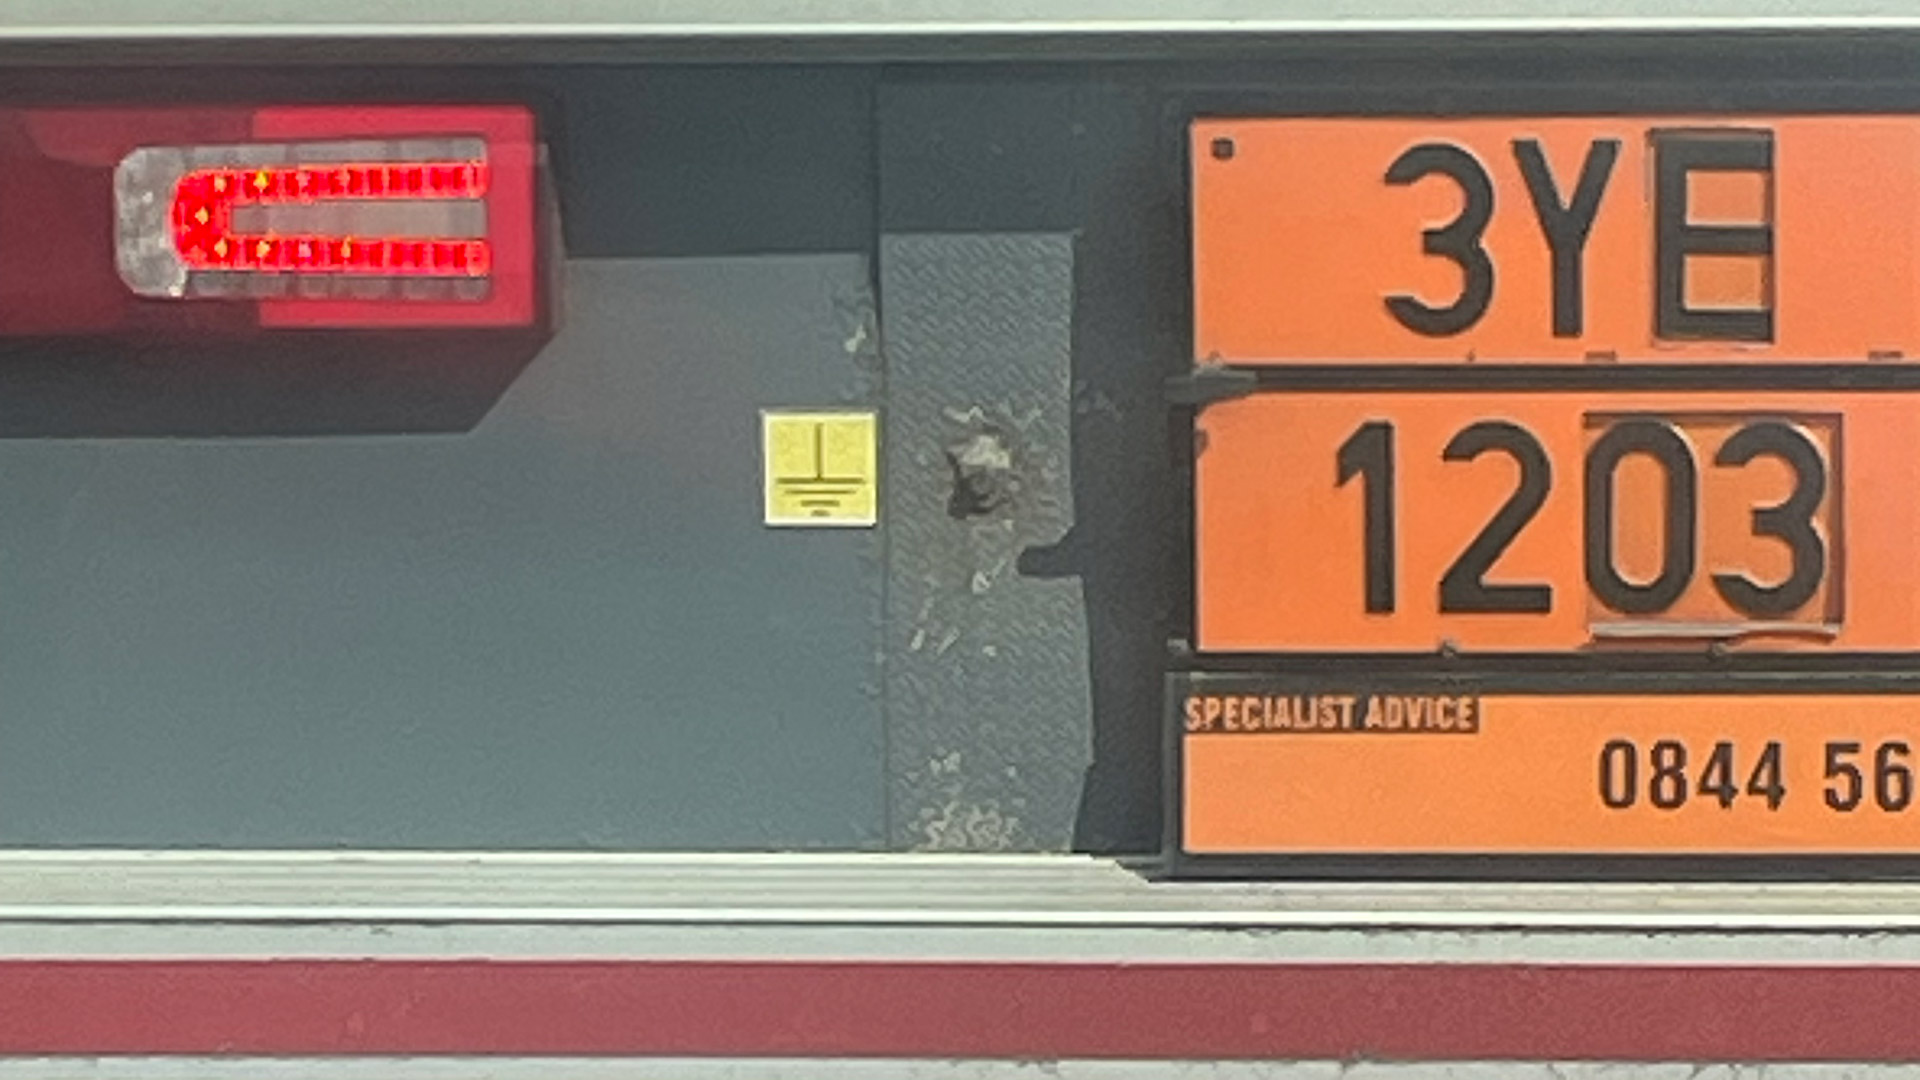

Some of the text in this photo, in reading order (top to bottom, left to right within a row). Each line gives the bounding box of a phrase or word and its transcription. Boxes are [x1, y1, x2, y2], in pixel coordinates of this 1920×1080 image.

[1383, 128, 1775, 343] 3YE
[1335, 419, 1827, 619] 1203
[1185, 696, 1474, 732] SPECIALIST ADVICE
[1599, 739, 1915, 813] 0844 56
